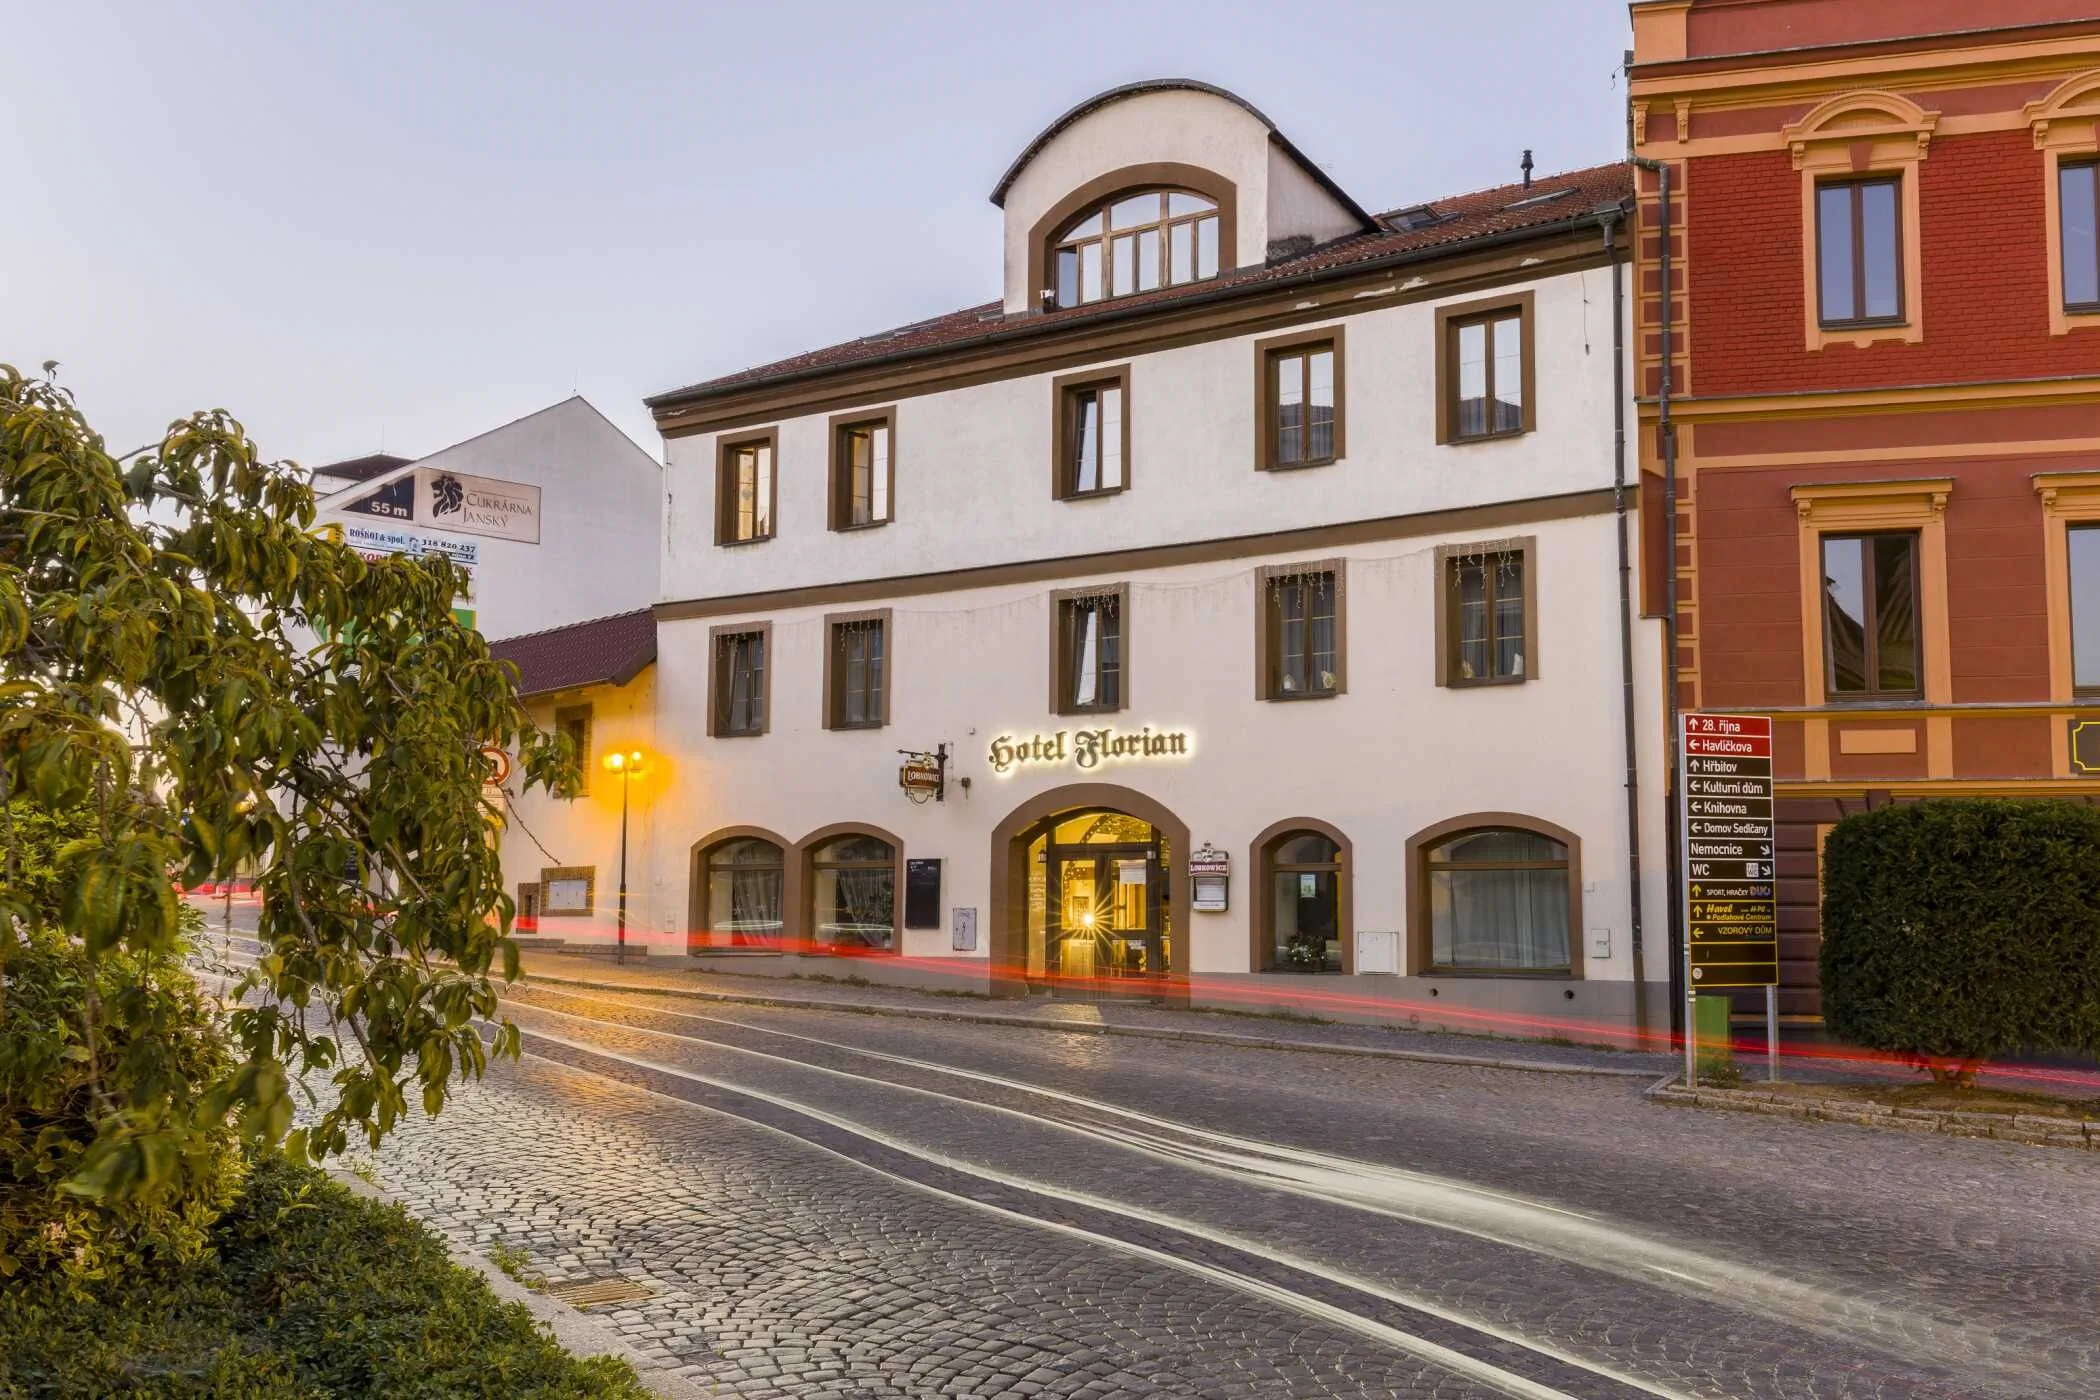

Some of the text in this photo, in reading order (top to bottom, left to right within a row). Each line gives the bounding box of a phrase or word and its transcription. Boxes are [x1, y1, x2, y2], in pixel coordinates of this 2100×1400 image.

[371, 501, 408, 517] 55 m
[467, 493, 533, 516] CUKRÁRNA
[387, 535, 406, 545] spol.
[1702, 719, 1741, 735] 28. října
[988, 727, 1188, 773] Hotel Florian
[1702, 739, 1752, 753] Havlíčkova
[1703, 759, 1738, 773] Hřbitov
[1703, 780, 1763, 794] Kulturní dům
[1704, 801, 1747, 814] Knihovna
[1704, 822, 1768, 837] Domov Sedlčany
[1691, 842, 1743, 856] Nemocnice
[1692, 863, 1710, 876] WC
[1745, 913, 1772, 921] Centrum
[1718, 925, 1772, 935] VZOROVÝ DŮM
